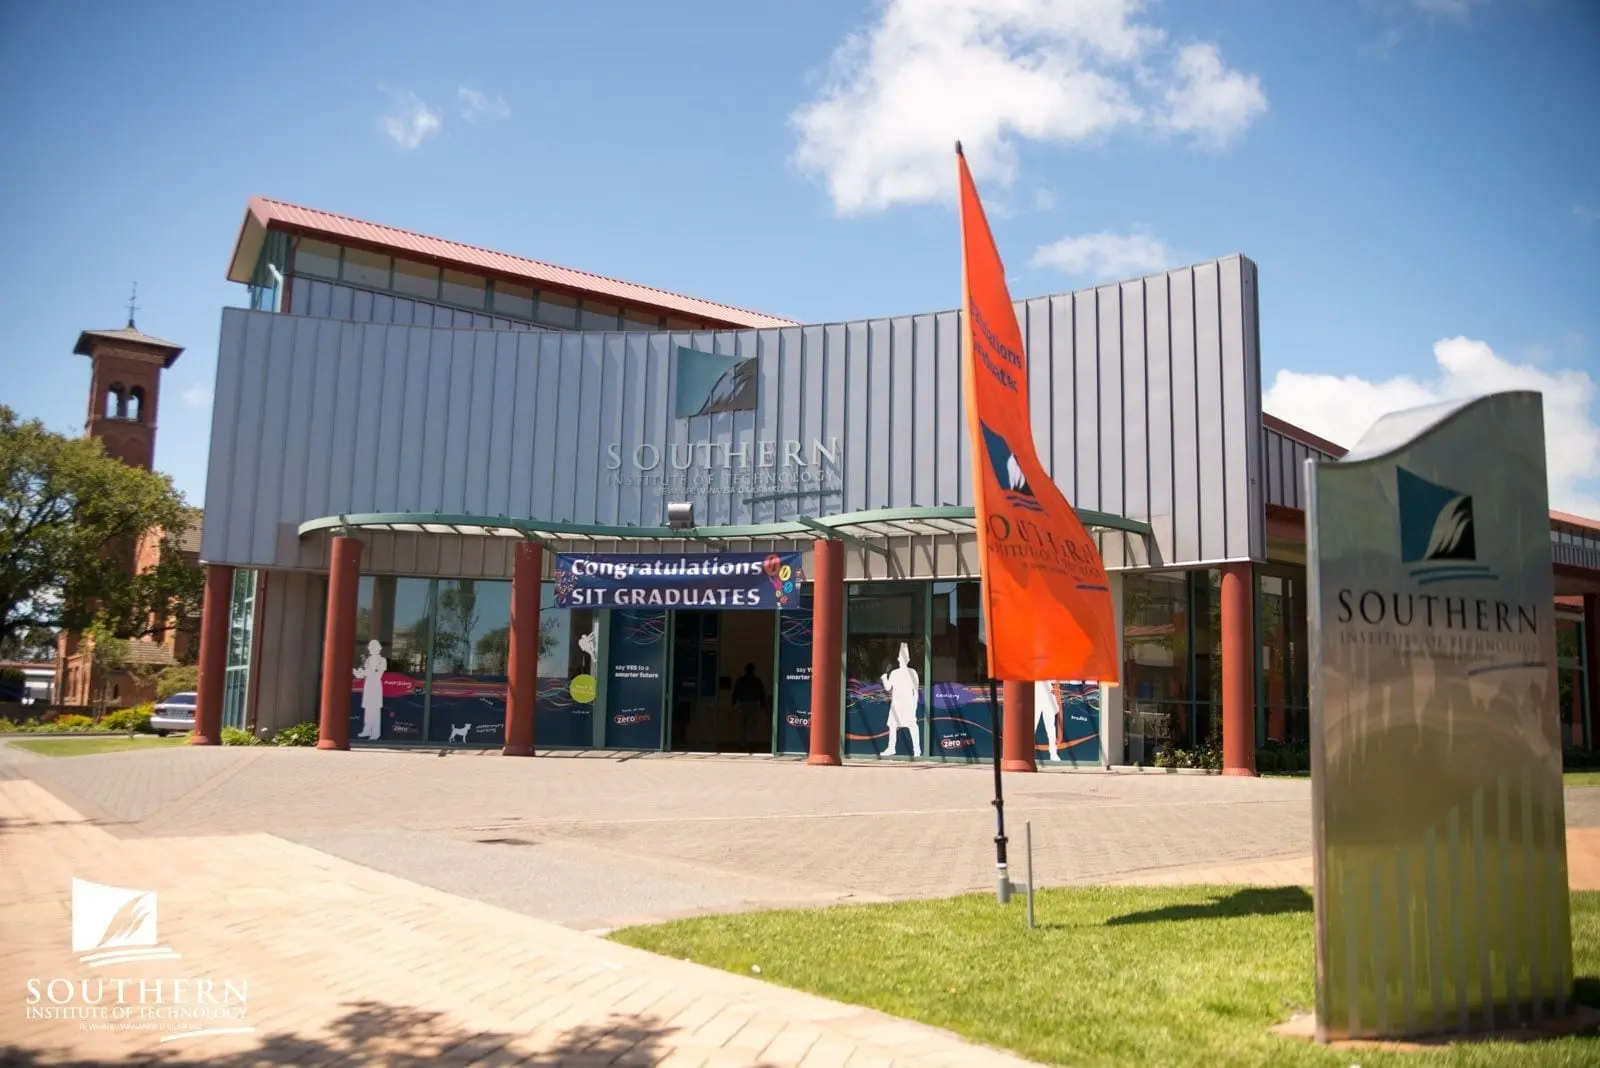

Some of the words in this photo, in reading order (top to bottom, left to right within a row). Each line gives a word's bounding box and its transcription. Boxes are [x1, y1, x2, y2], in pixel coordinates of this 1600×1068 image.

[606, 436, 840, 470] SOUTHERN
[606, 475, 687, 486] INSTITUTE
[693, 475, 714, 485] OF
[725, 470, 836, 485] TECHNOLOGY
[571, 557, 763, 580] Congratulations
[571, 588, 607, 605] SIT
[614, 588, 761, 606] GRADUATES
[1338, 588, 1538, 635] SOUTHERN
